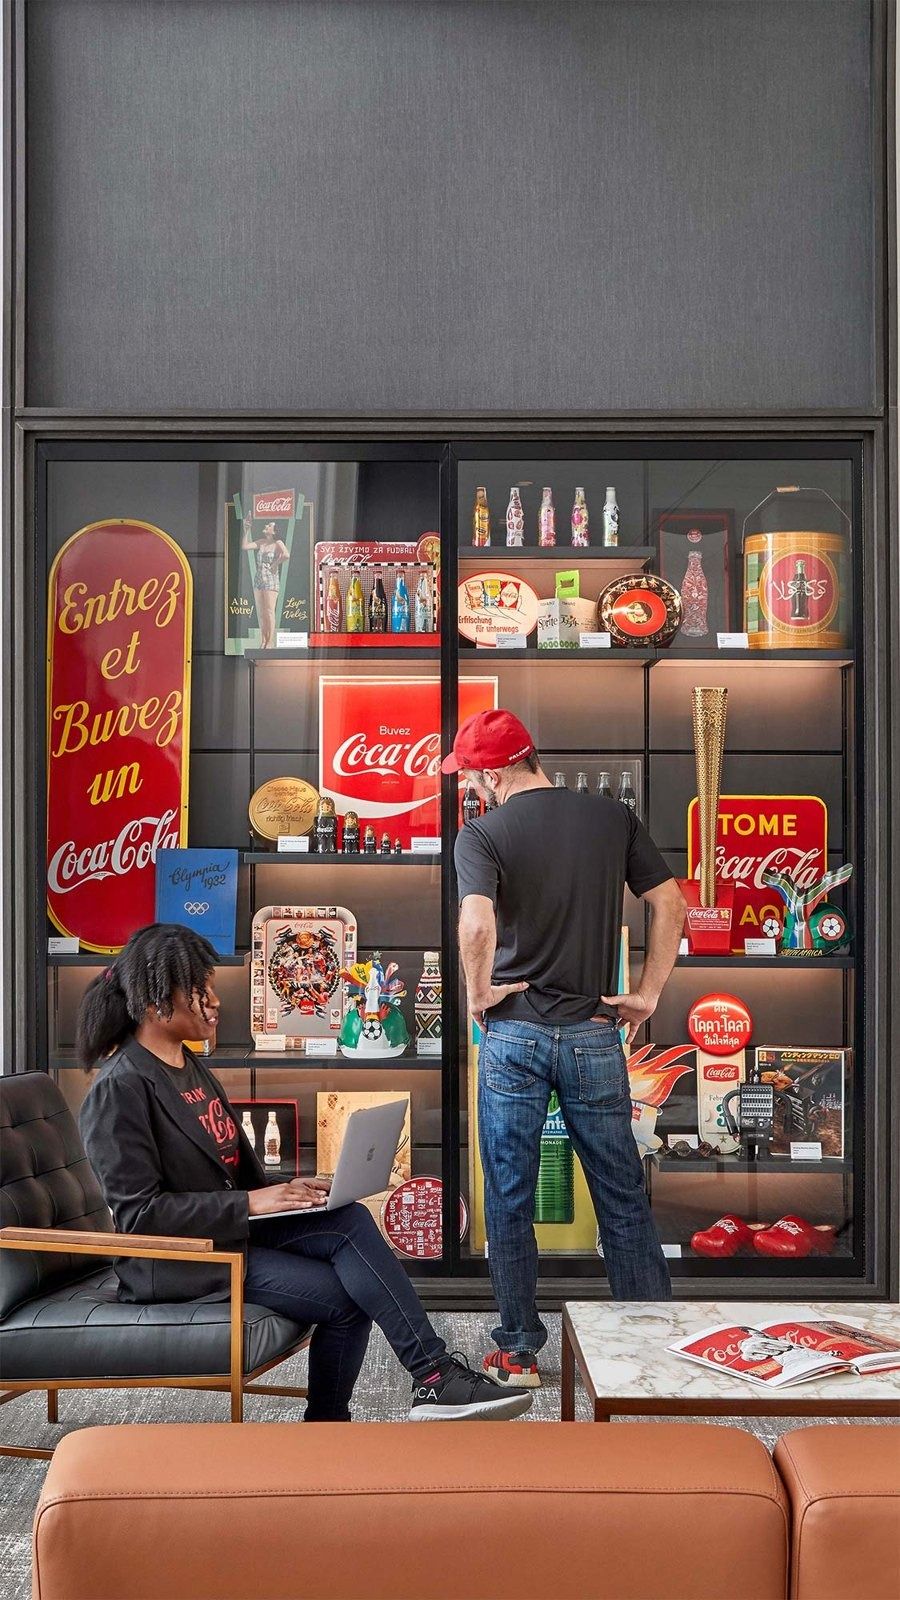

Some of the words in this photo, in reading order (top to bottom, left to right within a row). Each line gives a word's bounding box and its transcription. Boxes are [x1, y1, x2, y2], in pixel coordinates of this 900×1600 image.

[256, 497, 294, 513] Coca-Cola
[58, 571, 181, 635] Entrez
[231, 598, 239, 606] A
[475, 625, 485, 633] für
[486, 625, 519, 634] unterwegs
[538, 614, 559, 630] Sprite
[101, 631, 141, 680] et
[52, 690, 182, 758] Buvez
[379, 725, 411, 736] Buvez
[332, 733, 441, 777] Coca-Co
[87, 761, 144, 806] un
[717, 814, 798, 836] TOME
[47, 808, 179, 894] Coca-Cola
[168, 861, 231, 891] Olympia
[203, 874, 227, 891] 1932
[706, 1067, 736, 1079] Coca-Cola
[180, 1087, 207, 1104] RINK
[542, 1115, 566, 1130] nta
